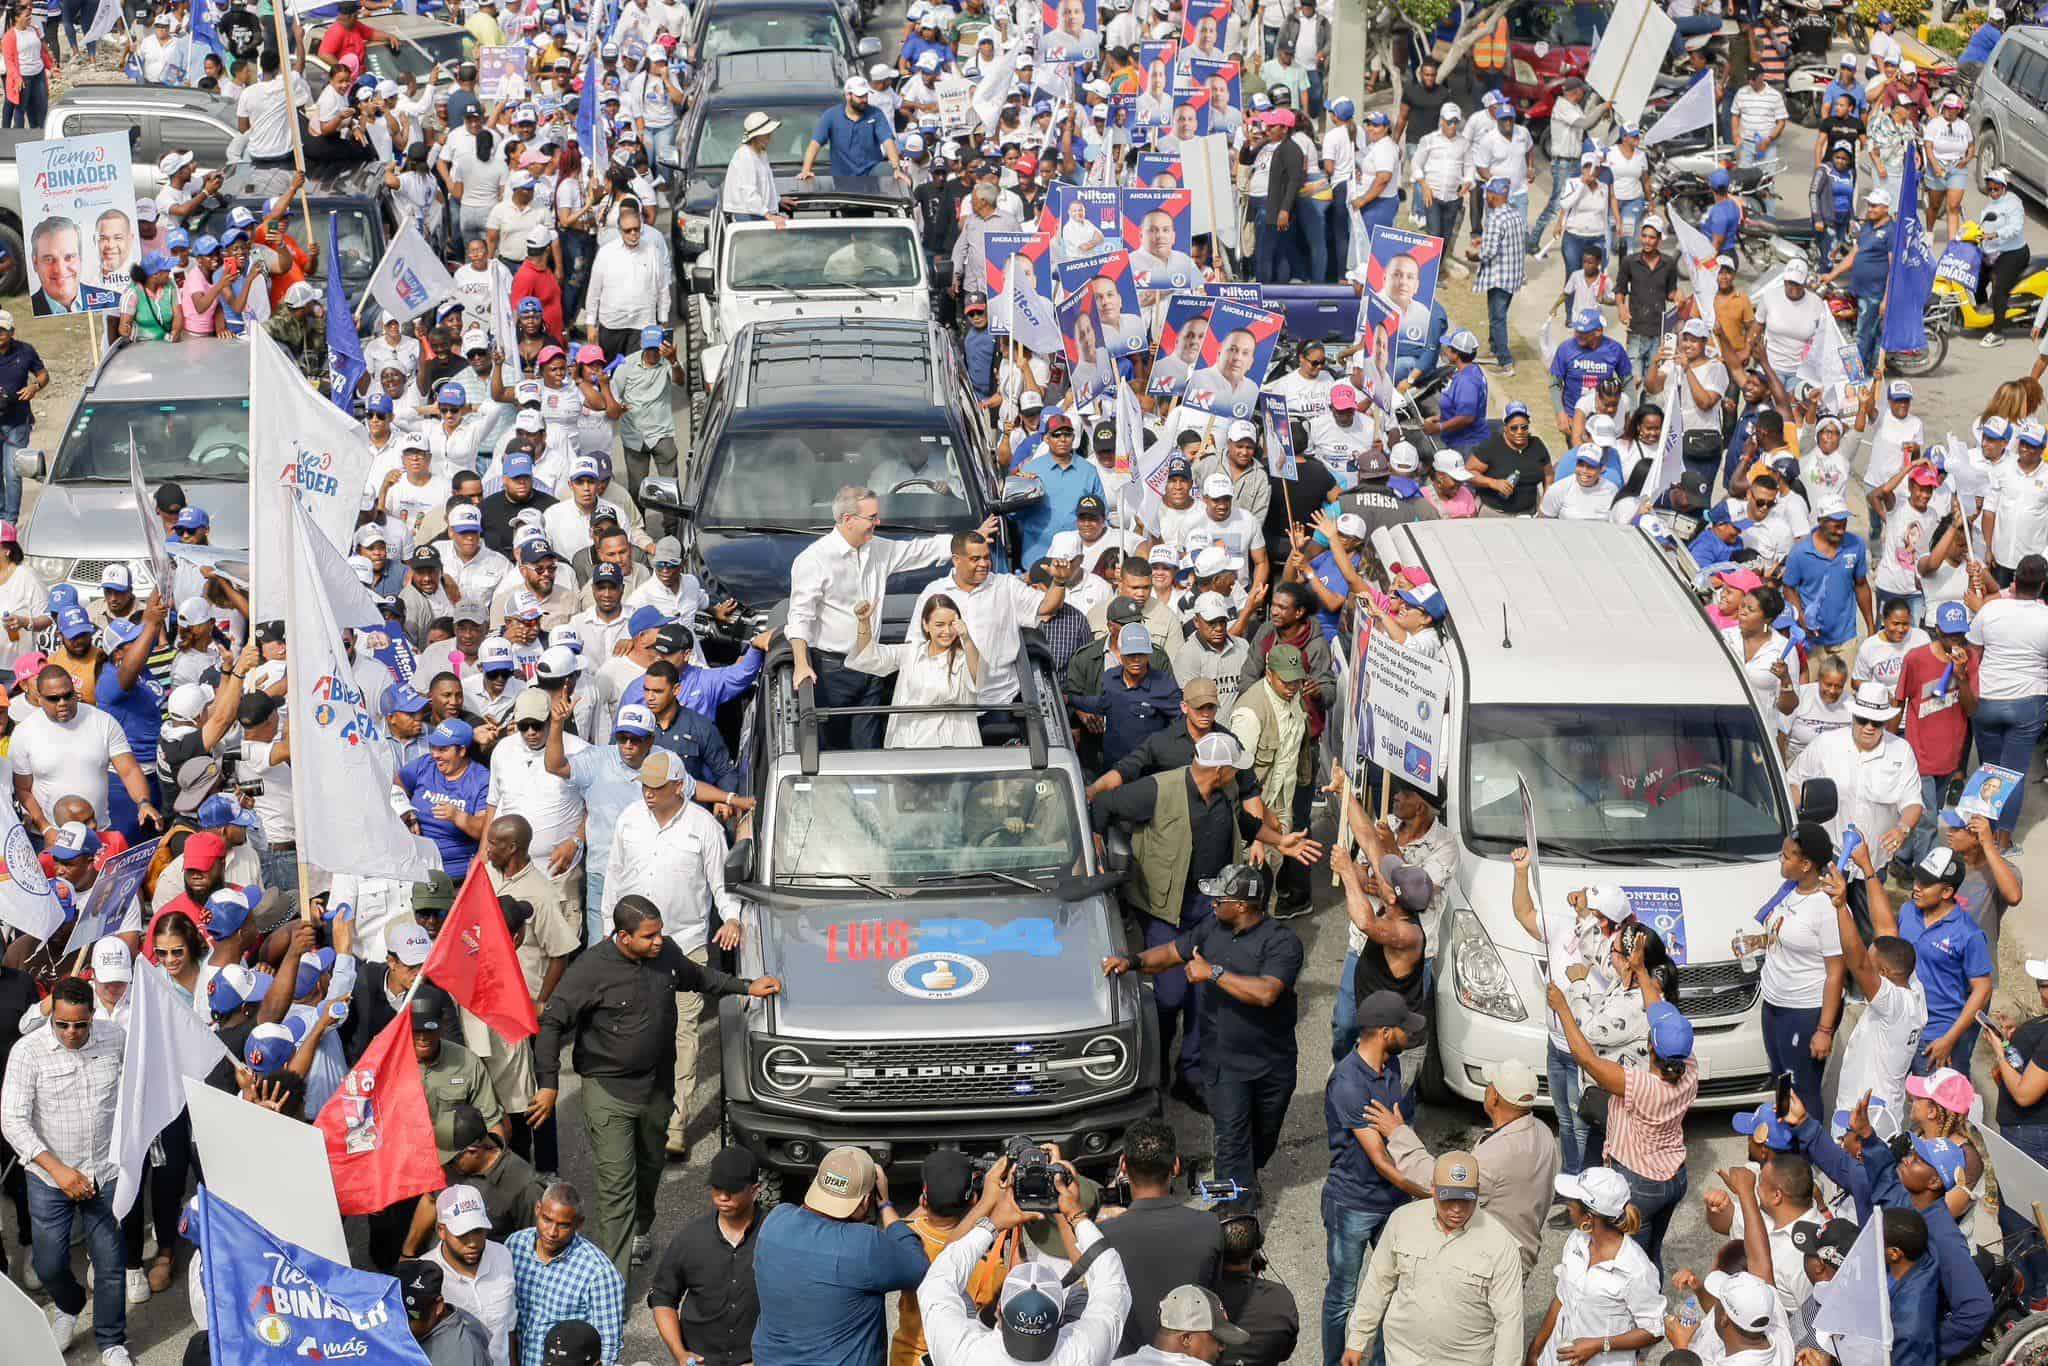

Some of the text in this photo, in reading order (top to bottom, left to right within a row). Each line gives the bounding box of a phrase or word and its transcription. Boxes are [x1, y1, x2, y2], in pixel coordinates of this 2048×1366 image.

[34, 164, 118, 191] ABINADER
[103, 271, 130, 287] Milto
[1219, 287, 1258, 297] Milton
[1574, 359, 1608, 373] Milton
[1356, 492, 1399, 510] PRENSA
[1373, 703, 1433, 746] FRANCISCO JUANA
[1381, 735, 1404, 760] Sigue
[1625, 891, 1680, 901] ONTERO
[825, 919, 911, 965] LUIS
[852, 1061, 1042, 1079] BRONCO
[824, 1175, 847, 1188] UTAH
[323, 1336, 368, 1358] más
